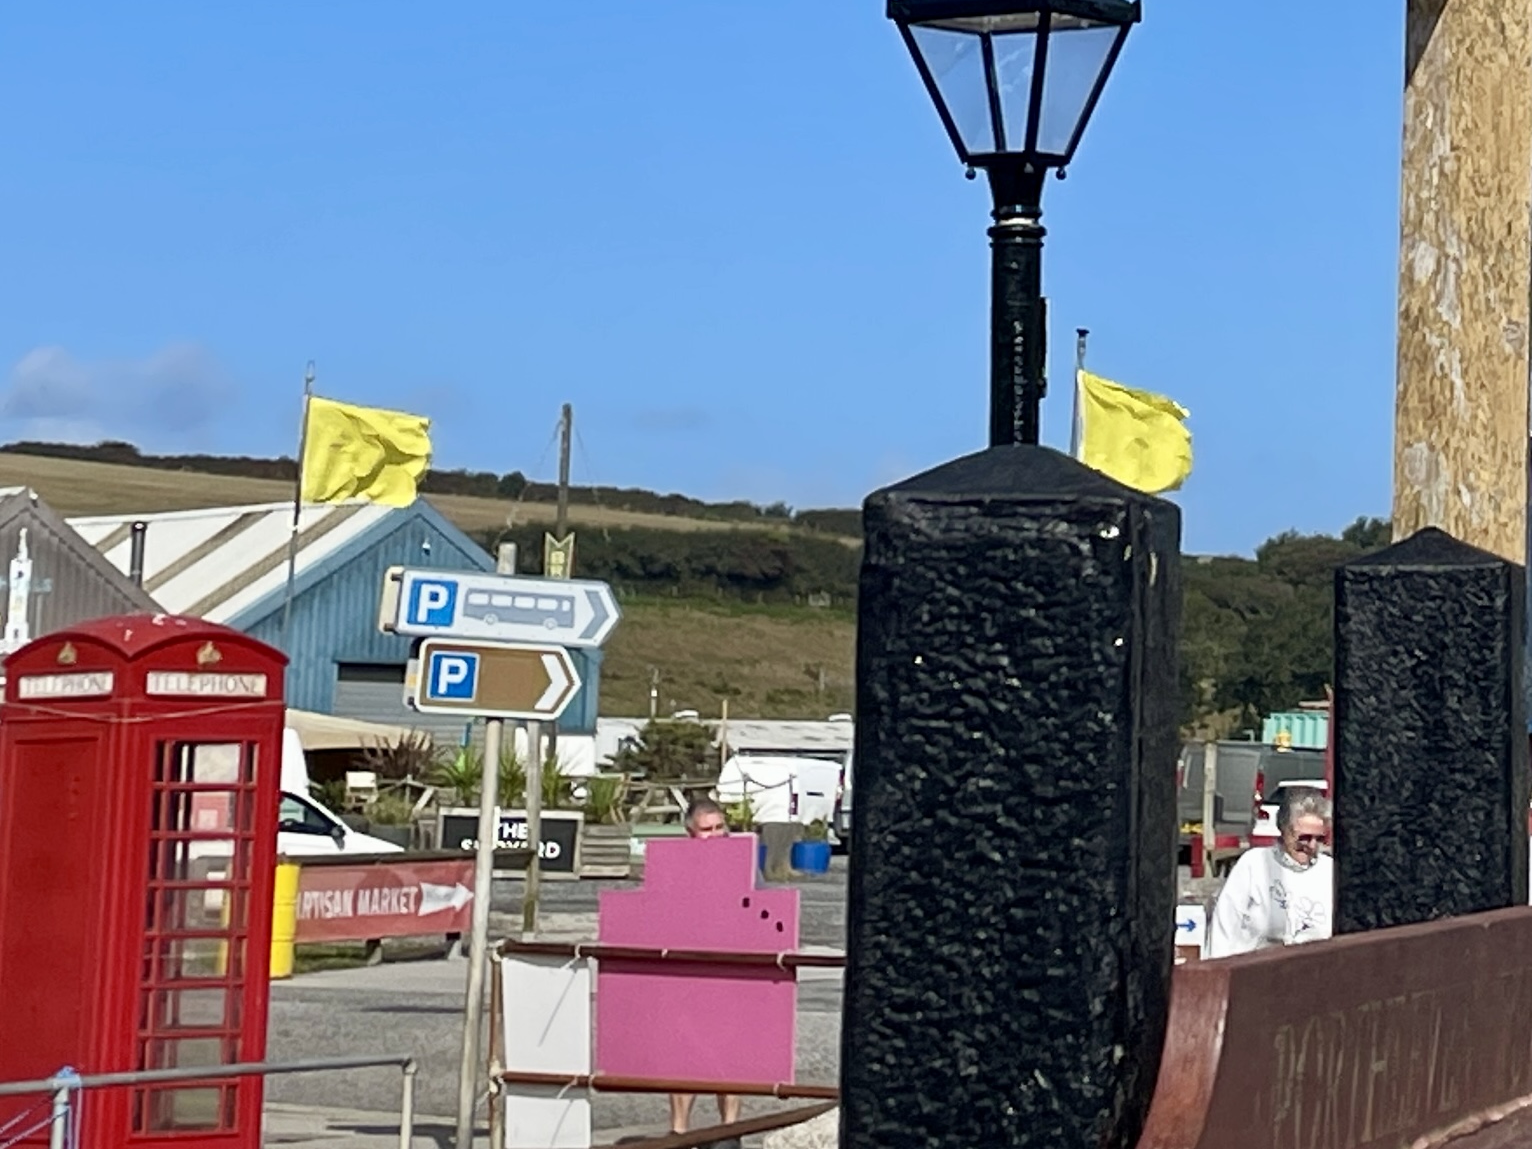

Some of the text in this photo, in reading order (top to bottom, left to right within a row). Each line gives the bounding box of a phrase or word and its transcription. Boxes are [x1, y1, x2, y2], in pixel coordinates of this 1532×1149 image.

[416, 583, 449, 623] P
[152, 674, 260, 695] TELEPHONE
[437, 657, 468, 695] P
[357, 886, 418, 916] MARKET
